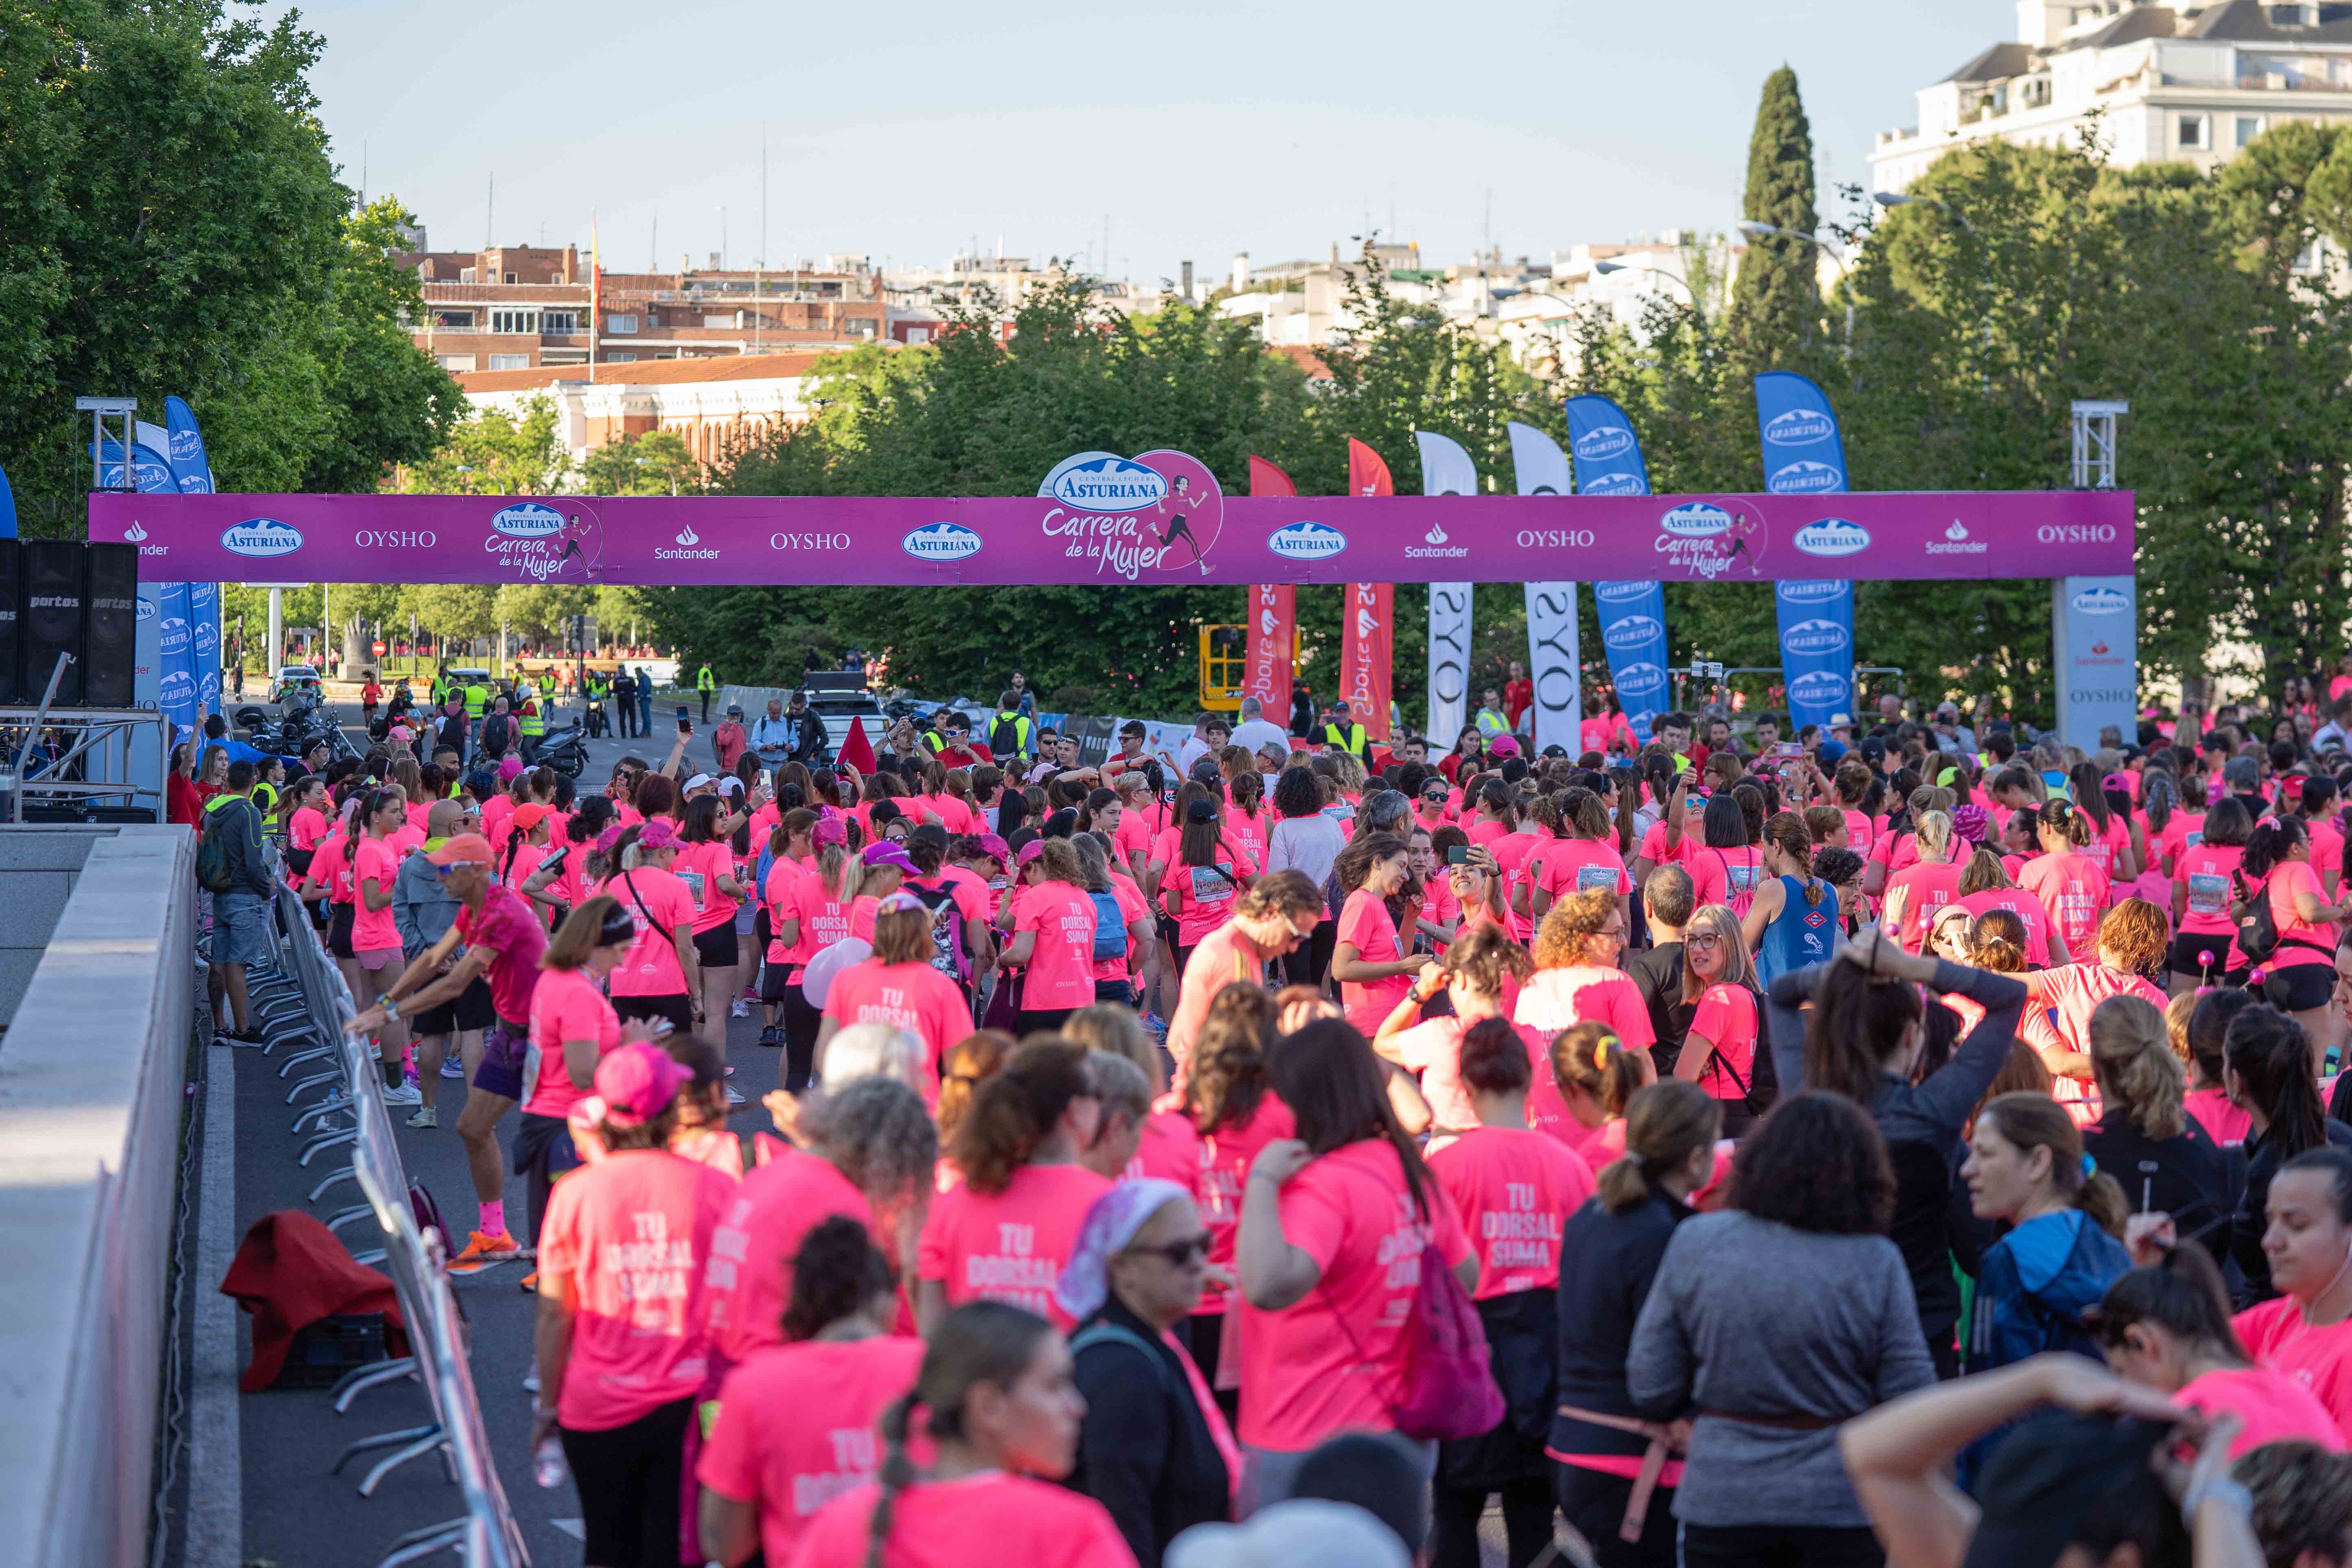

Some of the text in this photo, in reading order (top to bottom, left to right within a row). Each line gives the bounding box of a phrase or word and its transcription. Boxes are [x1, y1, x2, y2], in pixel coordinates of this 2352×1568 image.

[1061, 477, 1158, 498] ASTURIANA
[497, 515, 560, 529] ASTURIANA
[1042, 508, 1137, 537] Carrera
[227, 532, 297, 547] ASTURIANA
[355, 531, 436, 547] OYSHO
[771, 533, 850, 549] OYSHO
[1517, 530, 1595, 547] OYSHO
[1799, 532, 1865, 546] ASTURIANA
[2037, 524, 2116, 544] OYSHO
[485, 535, 546, 553] Carrera
[908, 536, 976, 551] ASTURIANA
[1274, 535, 1340, 550] ASTURIANA
[1654, 534, 1714, 553] Carrera
[1926, 541, 1988, 555] Santander
[654, 548, 720, 560] Santander
[1066, 534, 1172, 580] de la Mujer
[1404, 546, 1468, 558] Santander
[499, 551, 568, 581] de la Mujer
[1669, 550, 1736, 579] de la Mujer
[30, 596, 79, 608] portos
[93, 598, 132, 609] portos
[2070, 688, 2133, 704] OYSHO
[1242, 828, 1252, 837] TU
[2069, 880, 2083, 894] TU
[1933, 890, 1948, 904] TU
[825, 902, 840, 915] TU
[1069, 902, 1081, 915] TU
[1061, 916, 1091, 930] DORSAL
[1066, 930, 1089, 943] SUMA
[880, 987, 903, 1005] TU
[1505, 1182, 1534, 1209] TU
[632, 1212, 667, 1239] TU
[1481, 1212, 1560, 1240] DORSAL
[998, 1223, 1034, 1256] TU
[1491, 1240, 1551, 1268] SUMA
[828, 1428, 876, 1471] TU
